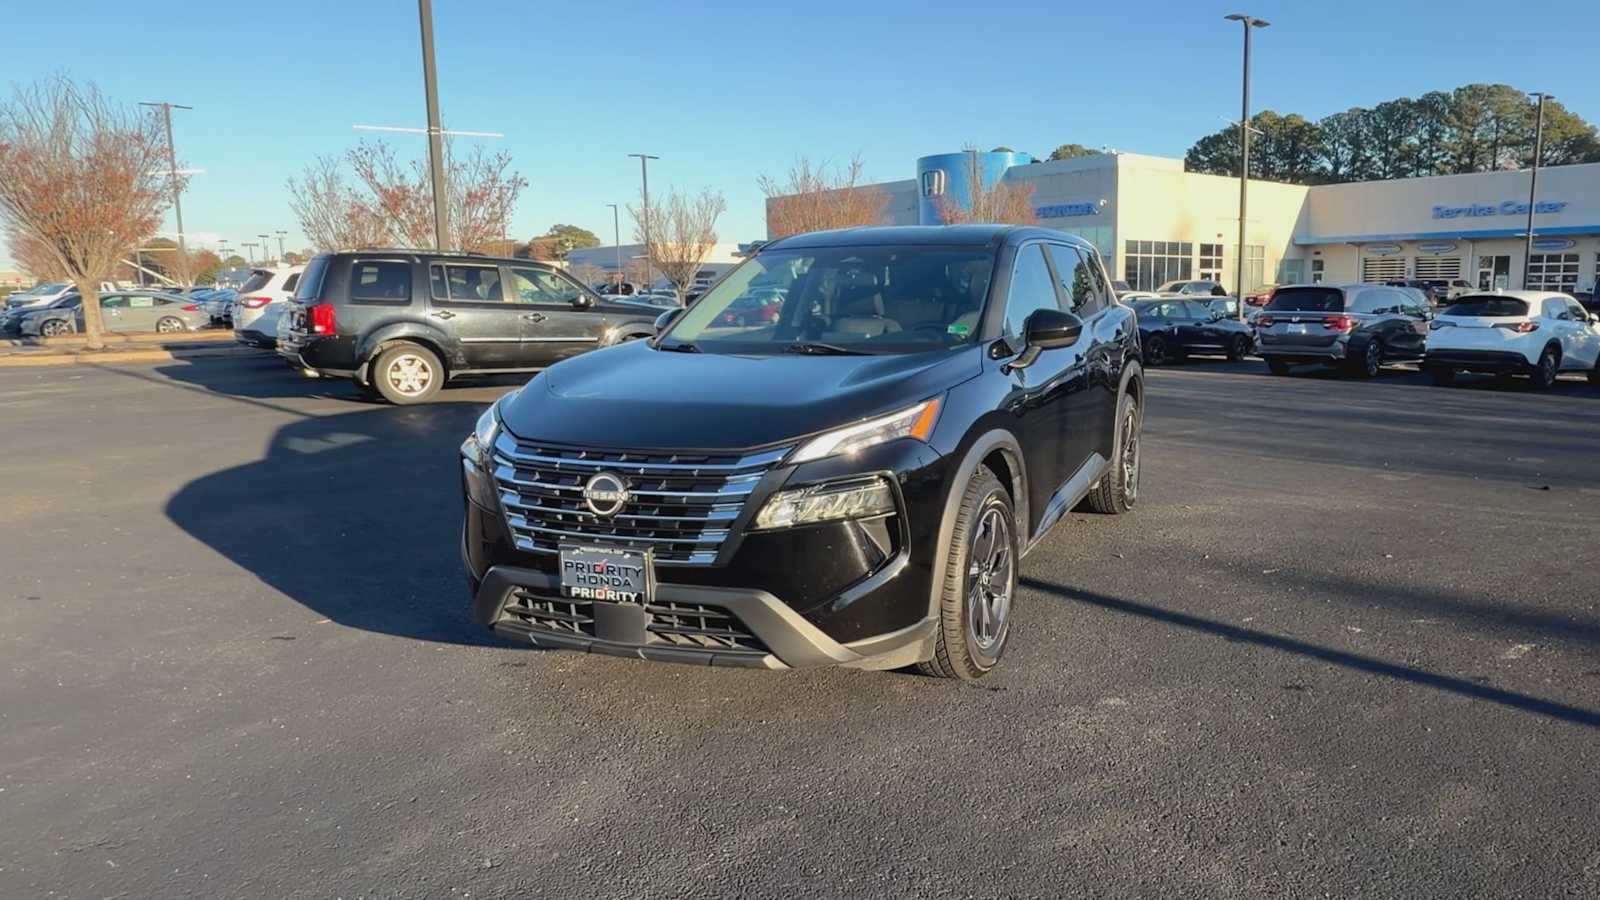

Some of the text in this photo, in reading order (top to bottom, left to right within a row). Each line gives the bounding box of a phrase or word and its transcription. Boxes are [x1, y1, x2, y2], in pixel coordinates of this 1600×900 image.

[1432, 204, 1497, 219] Service
[564, 561, 642, 578] PRIORITY
[576, 574, 632, 587] HONDA
[571, 586, 637, 602] PRIORITY
